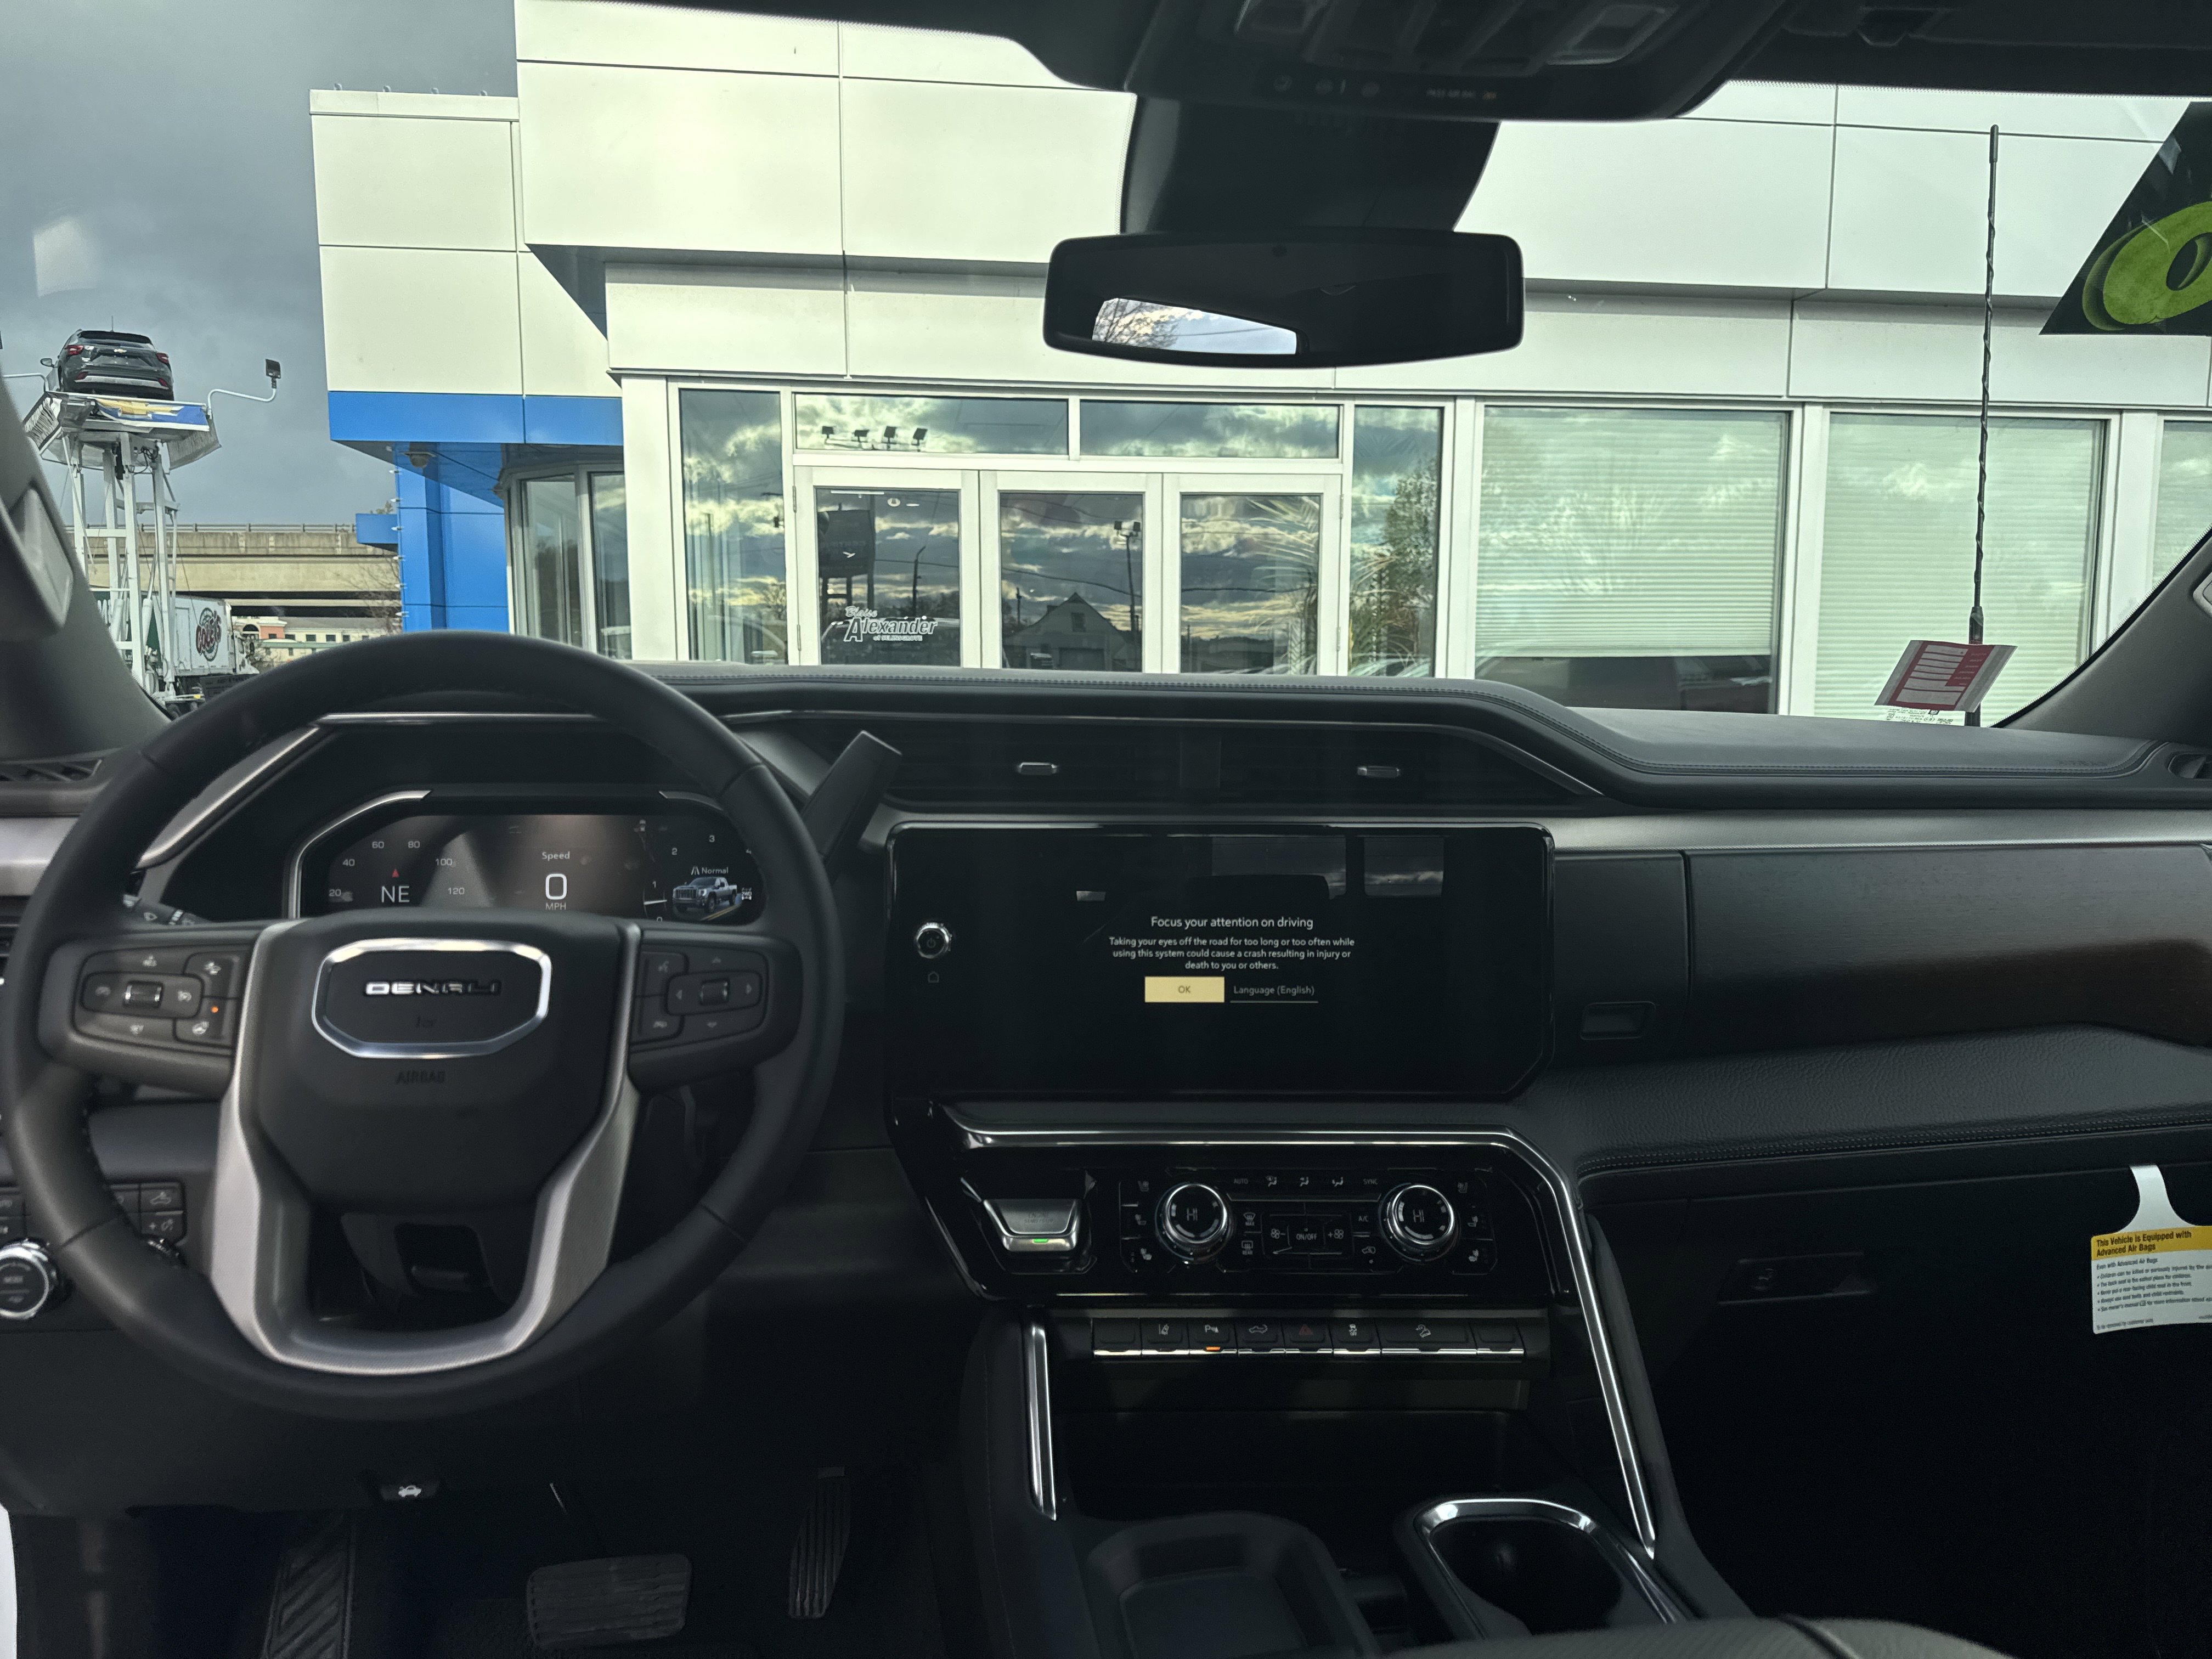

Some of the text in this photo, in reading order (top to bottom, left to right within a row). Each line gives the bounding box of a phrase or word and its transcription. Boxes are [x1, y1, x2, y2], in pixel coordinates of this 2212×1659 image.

[845, 606, 878, 618] Blaise
[843, 617, 938, 642] Alexander
[408, 840, 420, 849] 80
[541, 851, 570, 862] Speed
[448, 887, 465, 895] 120
[545, 873, 567, 900] 0
[381, 885, 410, 903] NE
[1150, 916, 1313, 930] Focus your attention on driving
[1109, 936, 1137, 947] Taking
[1138, 939, 1156, 947] your
[1158, 939, 1177, 947] eyes
[1179, 936, 1192, 946] off
[1193, 937, 1207, 946] the
[1209, 937, 1228, 946] road
[1230, 937, 1242, 946] for
[1260, 937, 1279, 948] long
[1308, 936, 1331, 946] often
[1333, 937, 1355, 946] while
[1113, 949, 1136, 960] using
[1138, 949, 1153, 957] this
[1155, 950, 1184, 960] system
[1186, 949, 1209, 957] could
[1244, 949, 1267, 958] crash
[1268, 949, 1305, 960] resulting
[1307, 950, 1314, 958] in
[1316, 950, 1340, 960] injury
[1184, 961, 1209, 969] death
[1221, 962, 1237, 971] you
[1249, 961, 1279, 969] others.
[365, 981, 501, 995] DENALI
[1178, 985, 1191, 994] OK
[1234, 985, 1315, 996] Language (English)
[1187, 1207, 1198, 1221] HI
[1413, 1209, 1425, 1223] HI
[2097, 1239, 2109, 1248] This
[2110, 1235, 2133, 1245] Vehicle
[2142, 1231, 2174, 1242] Equipped
[2176, 1231, 2192, 1239] with
[2097, 1245, 2126, 1257] Advanced
[2139, 1243, 2156, 1252] Bags
